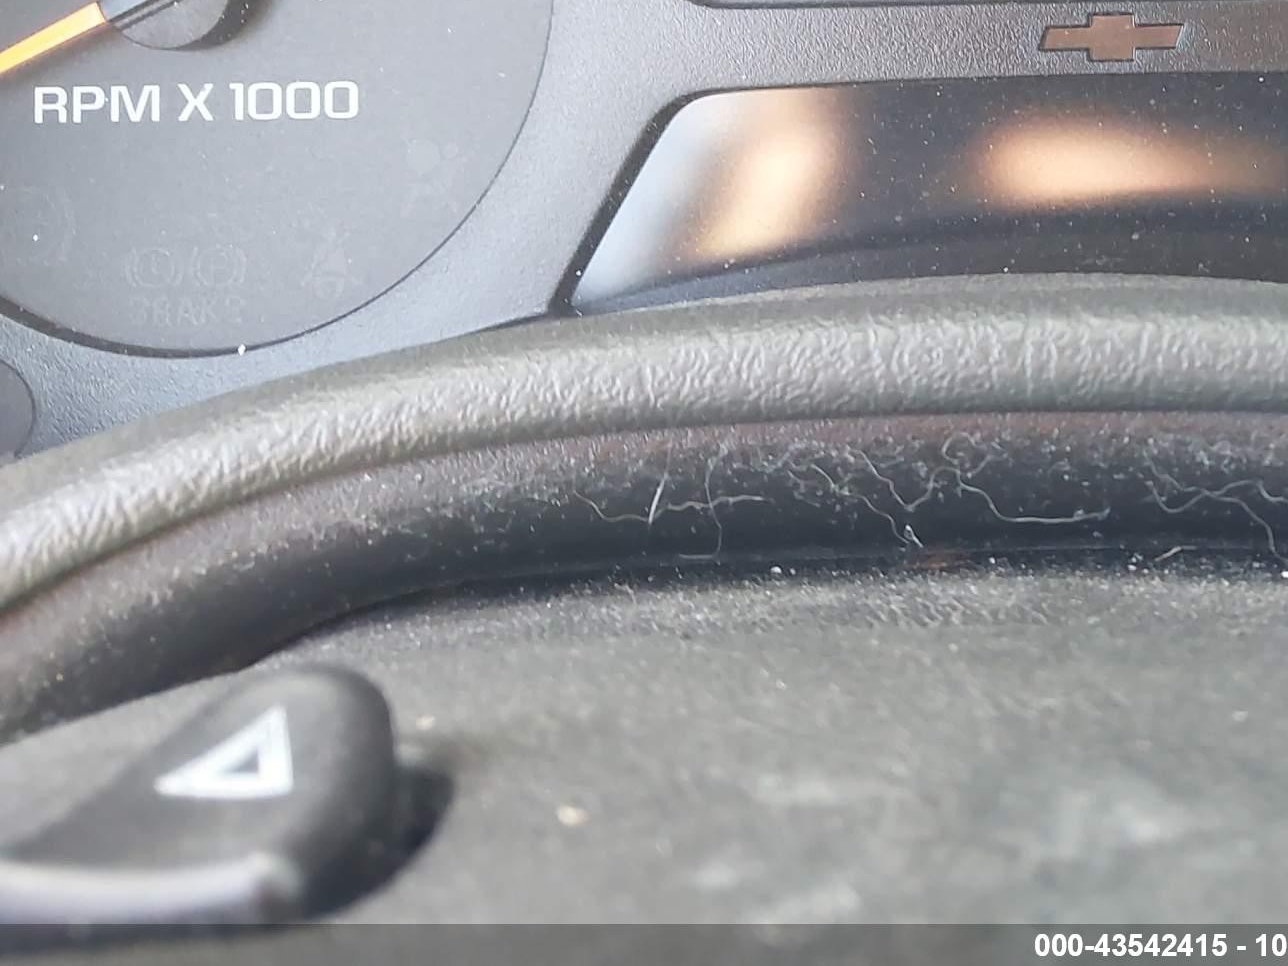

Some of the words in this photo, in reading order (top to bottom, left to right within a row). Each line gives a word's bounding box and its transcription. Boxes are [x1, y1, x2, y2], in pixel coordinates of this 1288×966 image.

[35, 85, 160, 123] RPM
[178, 83, 213, 121] X
[230, 81, 358, 120] 1000
